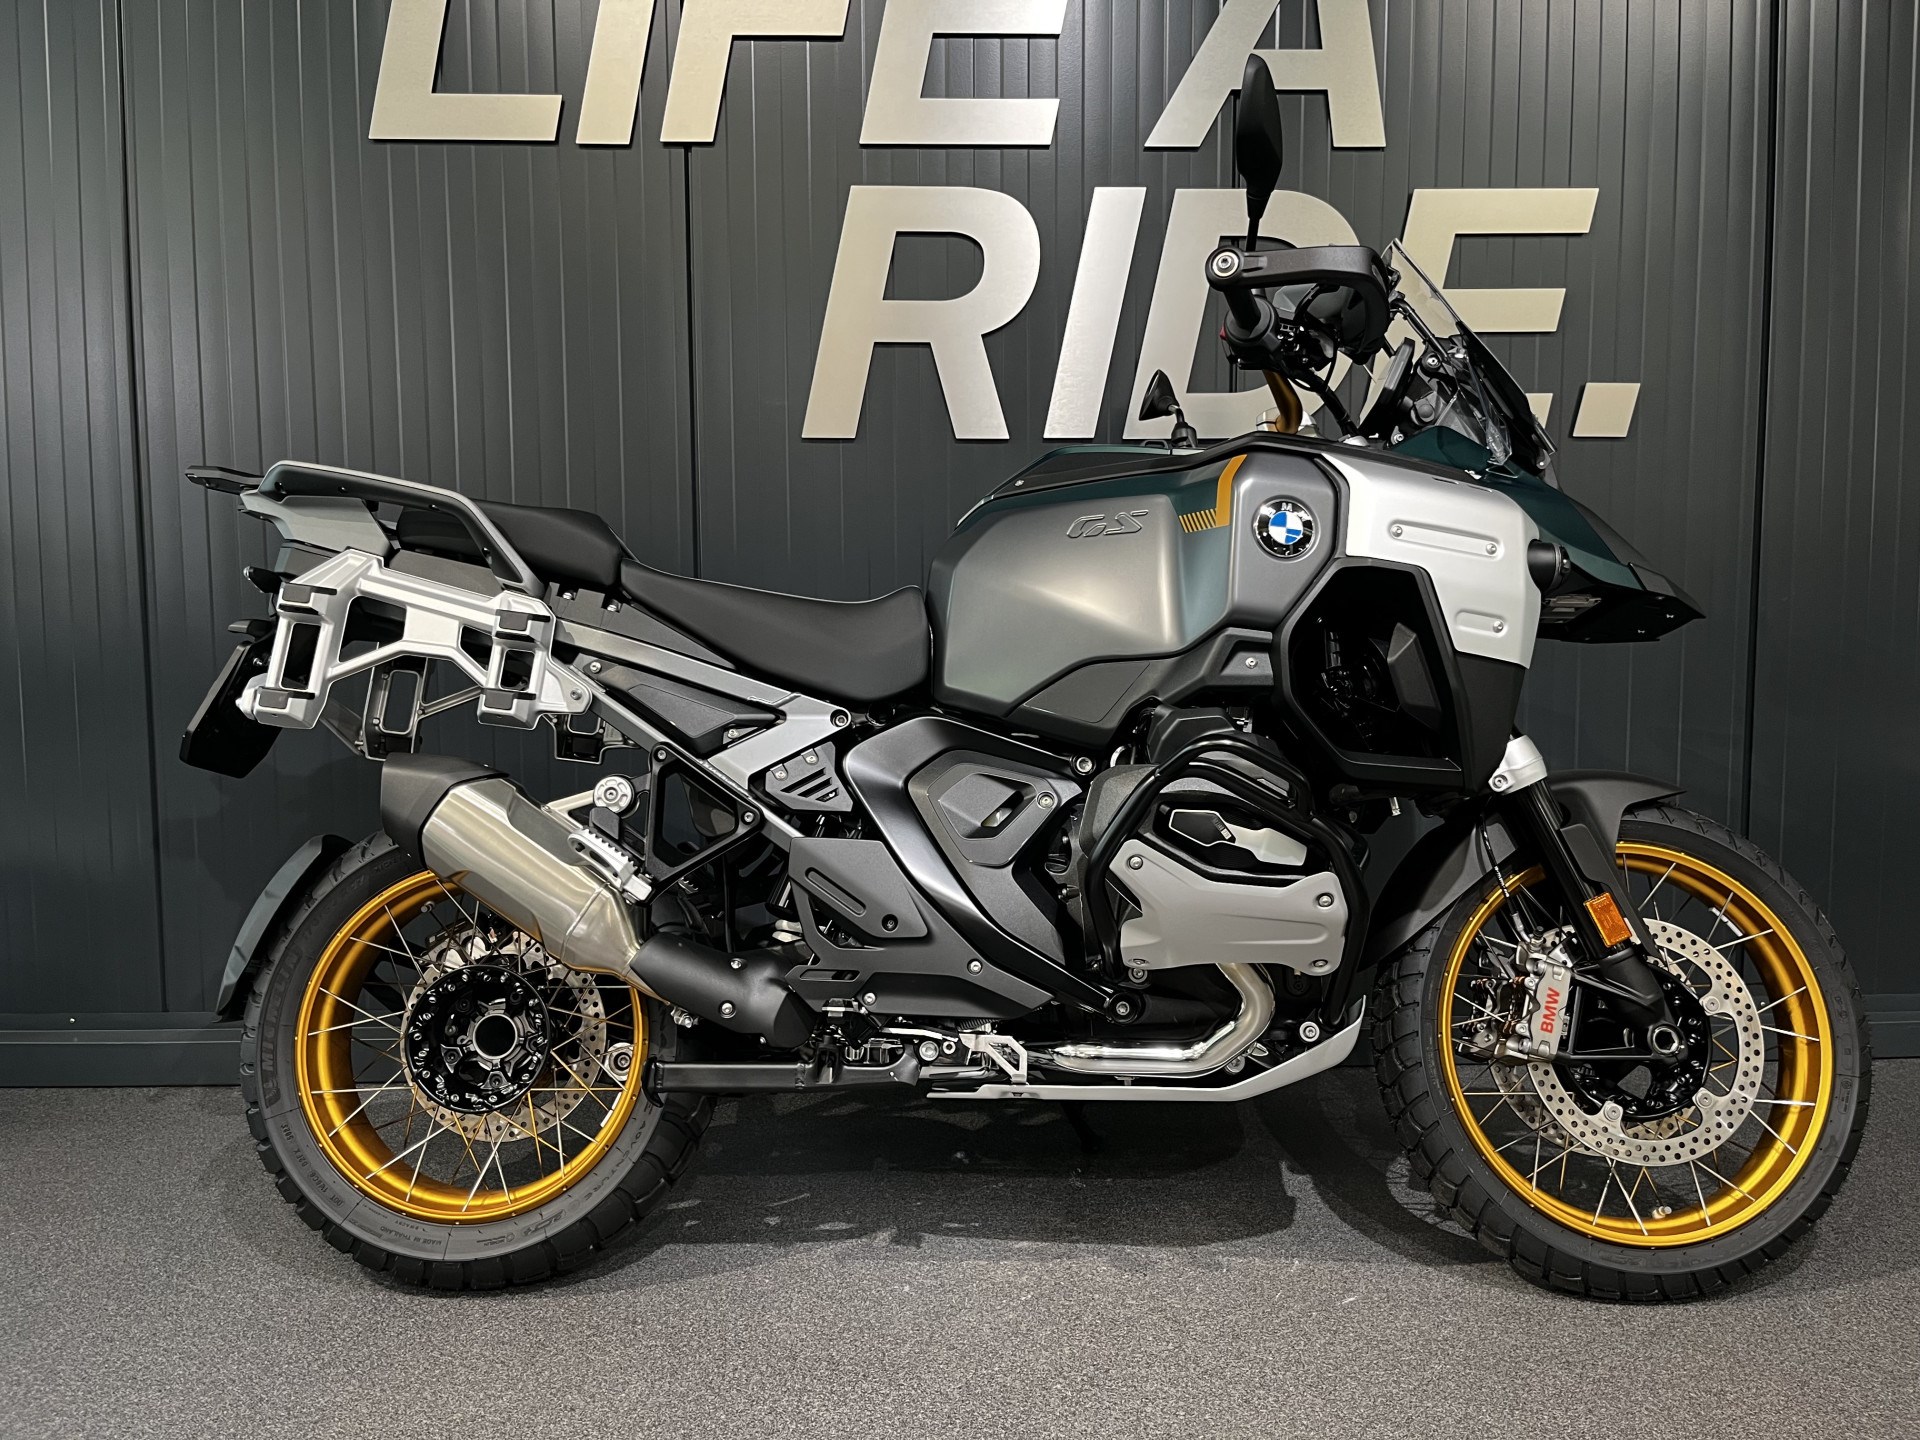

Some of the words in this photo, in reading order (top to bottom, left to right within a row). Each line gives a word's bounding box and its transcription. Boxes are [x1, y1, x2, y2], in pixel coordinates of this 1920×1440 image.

[369, 0, 1067, 146] LIFE
[1144, 0, 1386, 148] A
[802, 186, 1640, 439] RIDE.
[1066, 509, 1148, 538] GS
[1540, 987, 1560, 1034] BMW
